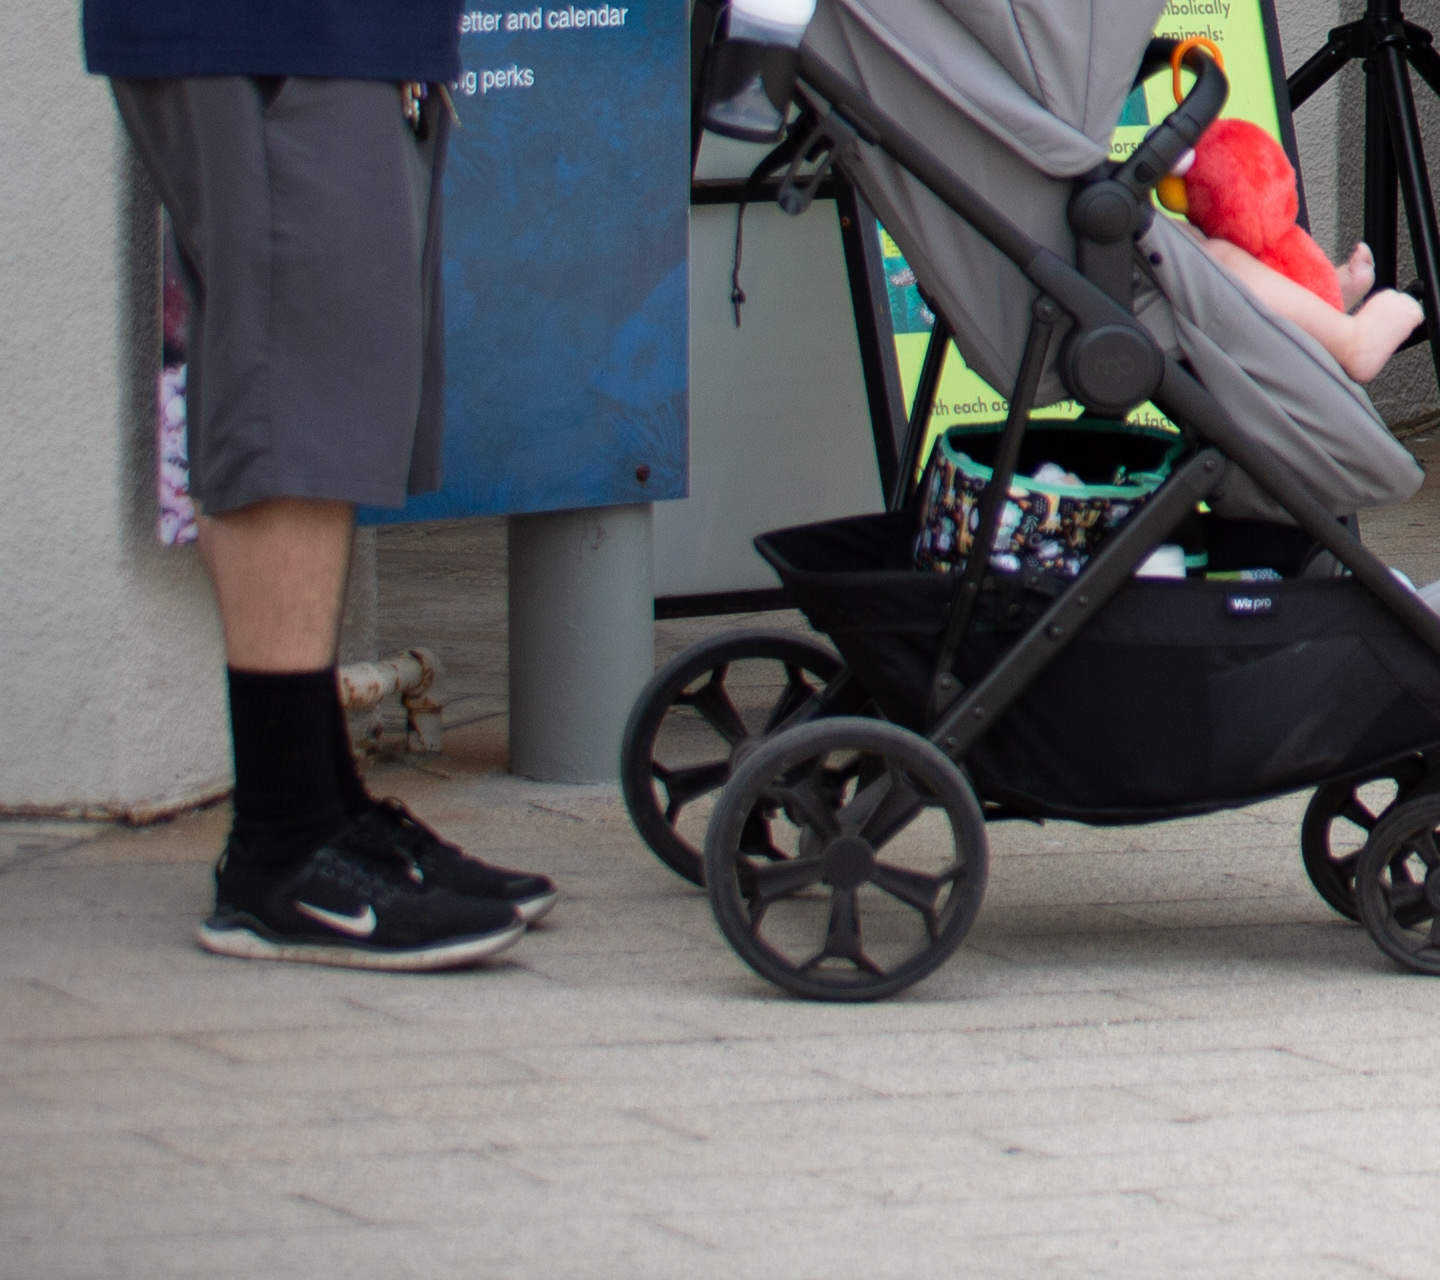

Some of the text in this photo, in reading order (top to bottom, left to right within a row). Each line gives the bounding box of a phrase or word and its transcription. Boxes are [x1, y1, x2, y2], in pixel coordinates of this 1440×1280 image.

[506, 4, 628, 30] and calendar
[482, 65, 534, 93] perks
[954, 400, 988, 414] each
